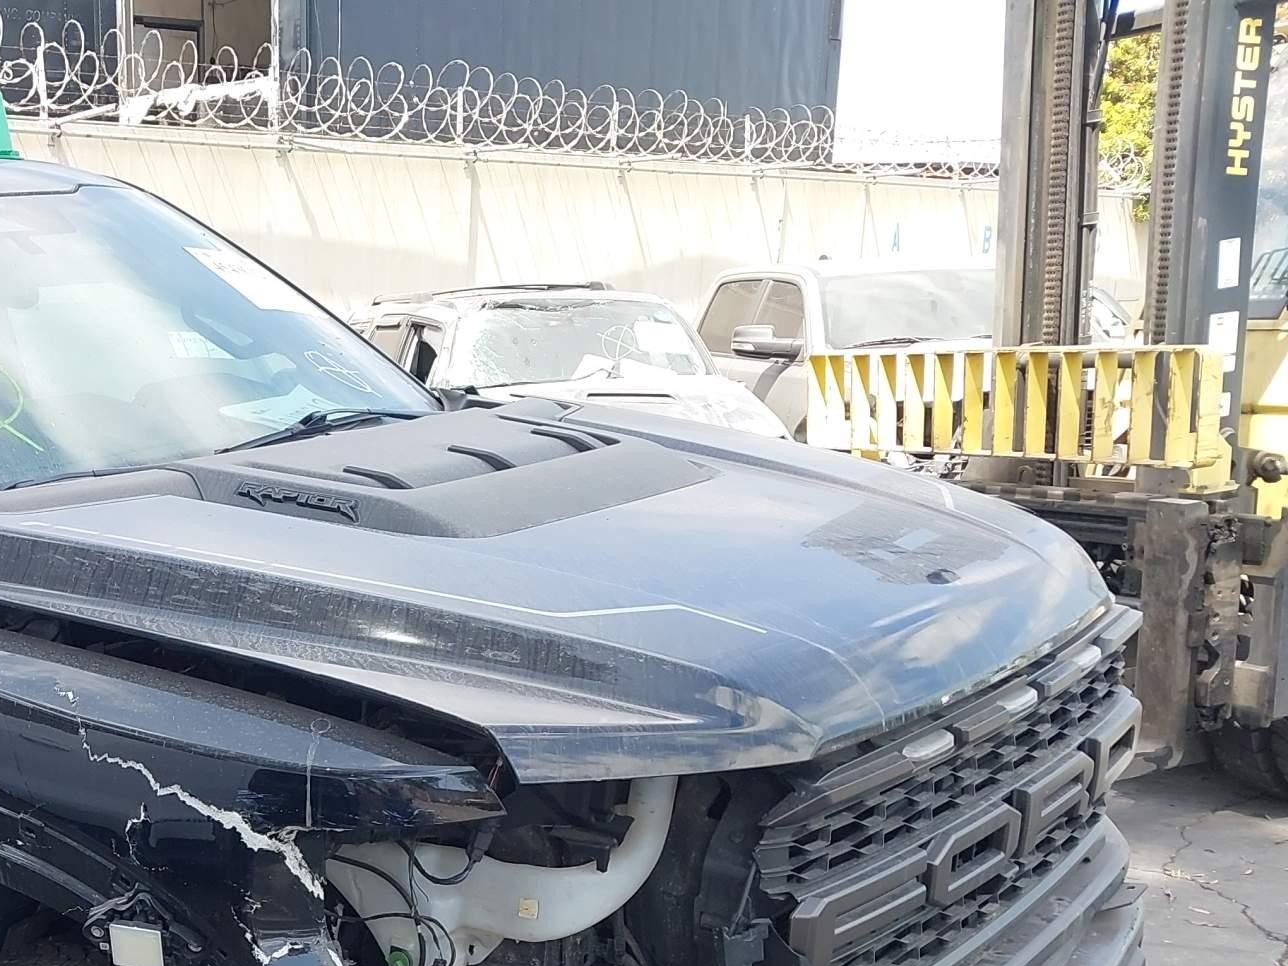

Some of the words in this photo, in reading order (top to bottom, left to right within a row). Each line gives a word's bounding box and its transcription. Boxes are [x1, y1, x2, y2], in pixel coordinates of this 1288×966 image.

[1226, 17, 1263, 176] HYSTER
[891, 222, 902, 252] A
[982, 225, 993, 255] B
[234, 480, 360, 524] RAPTOR
